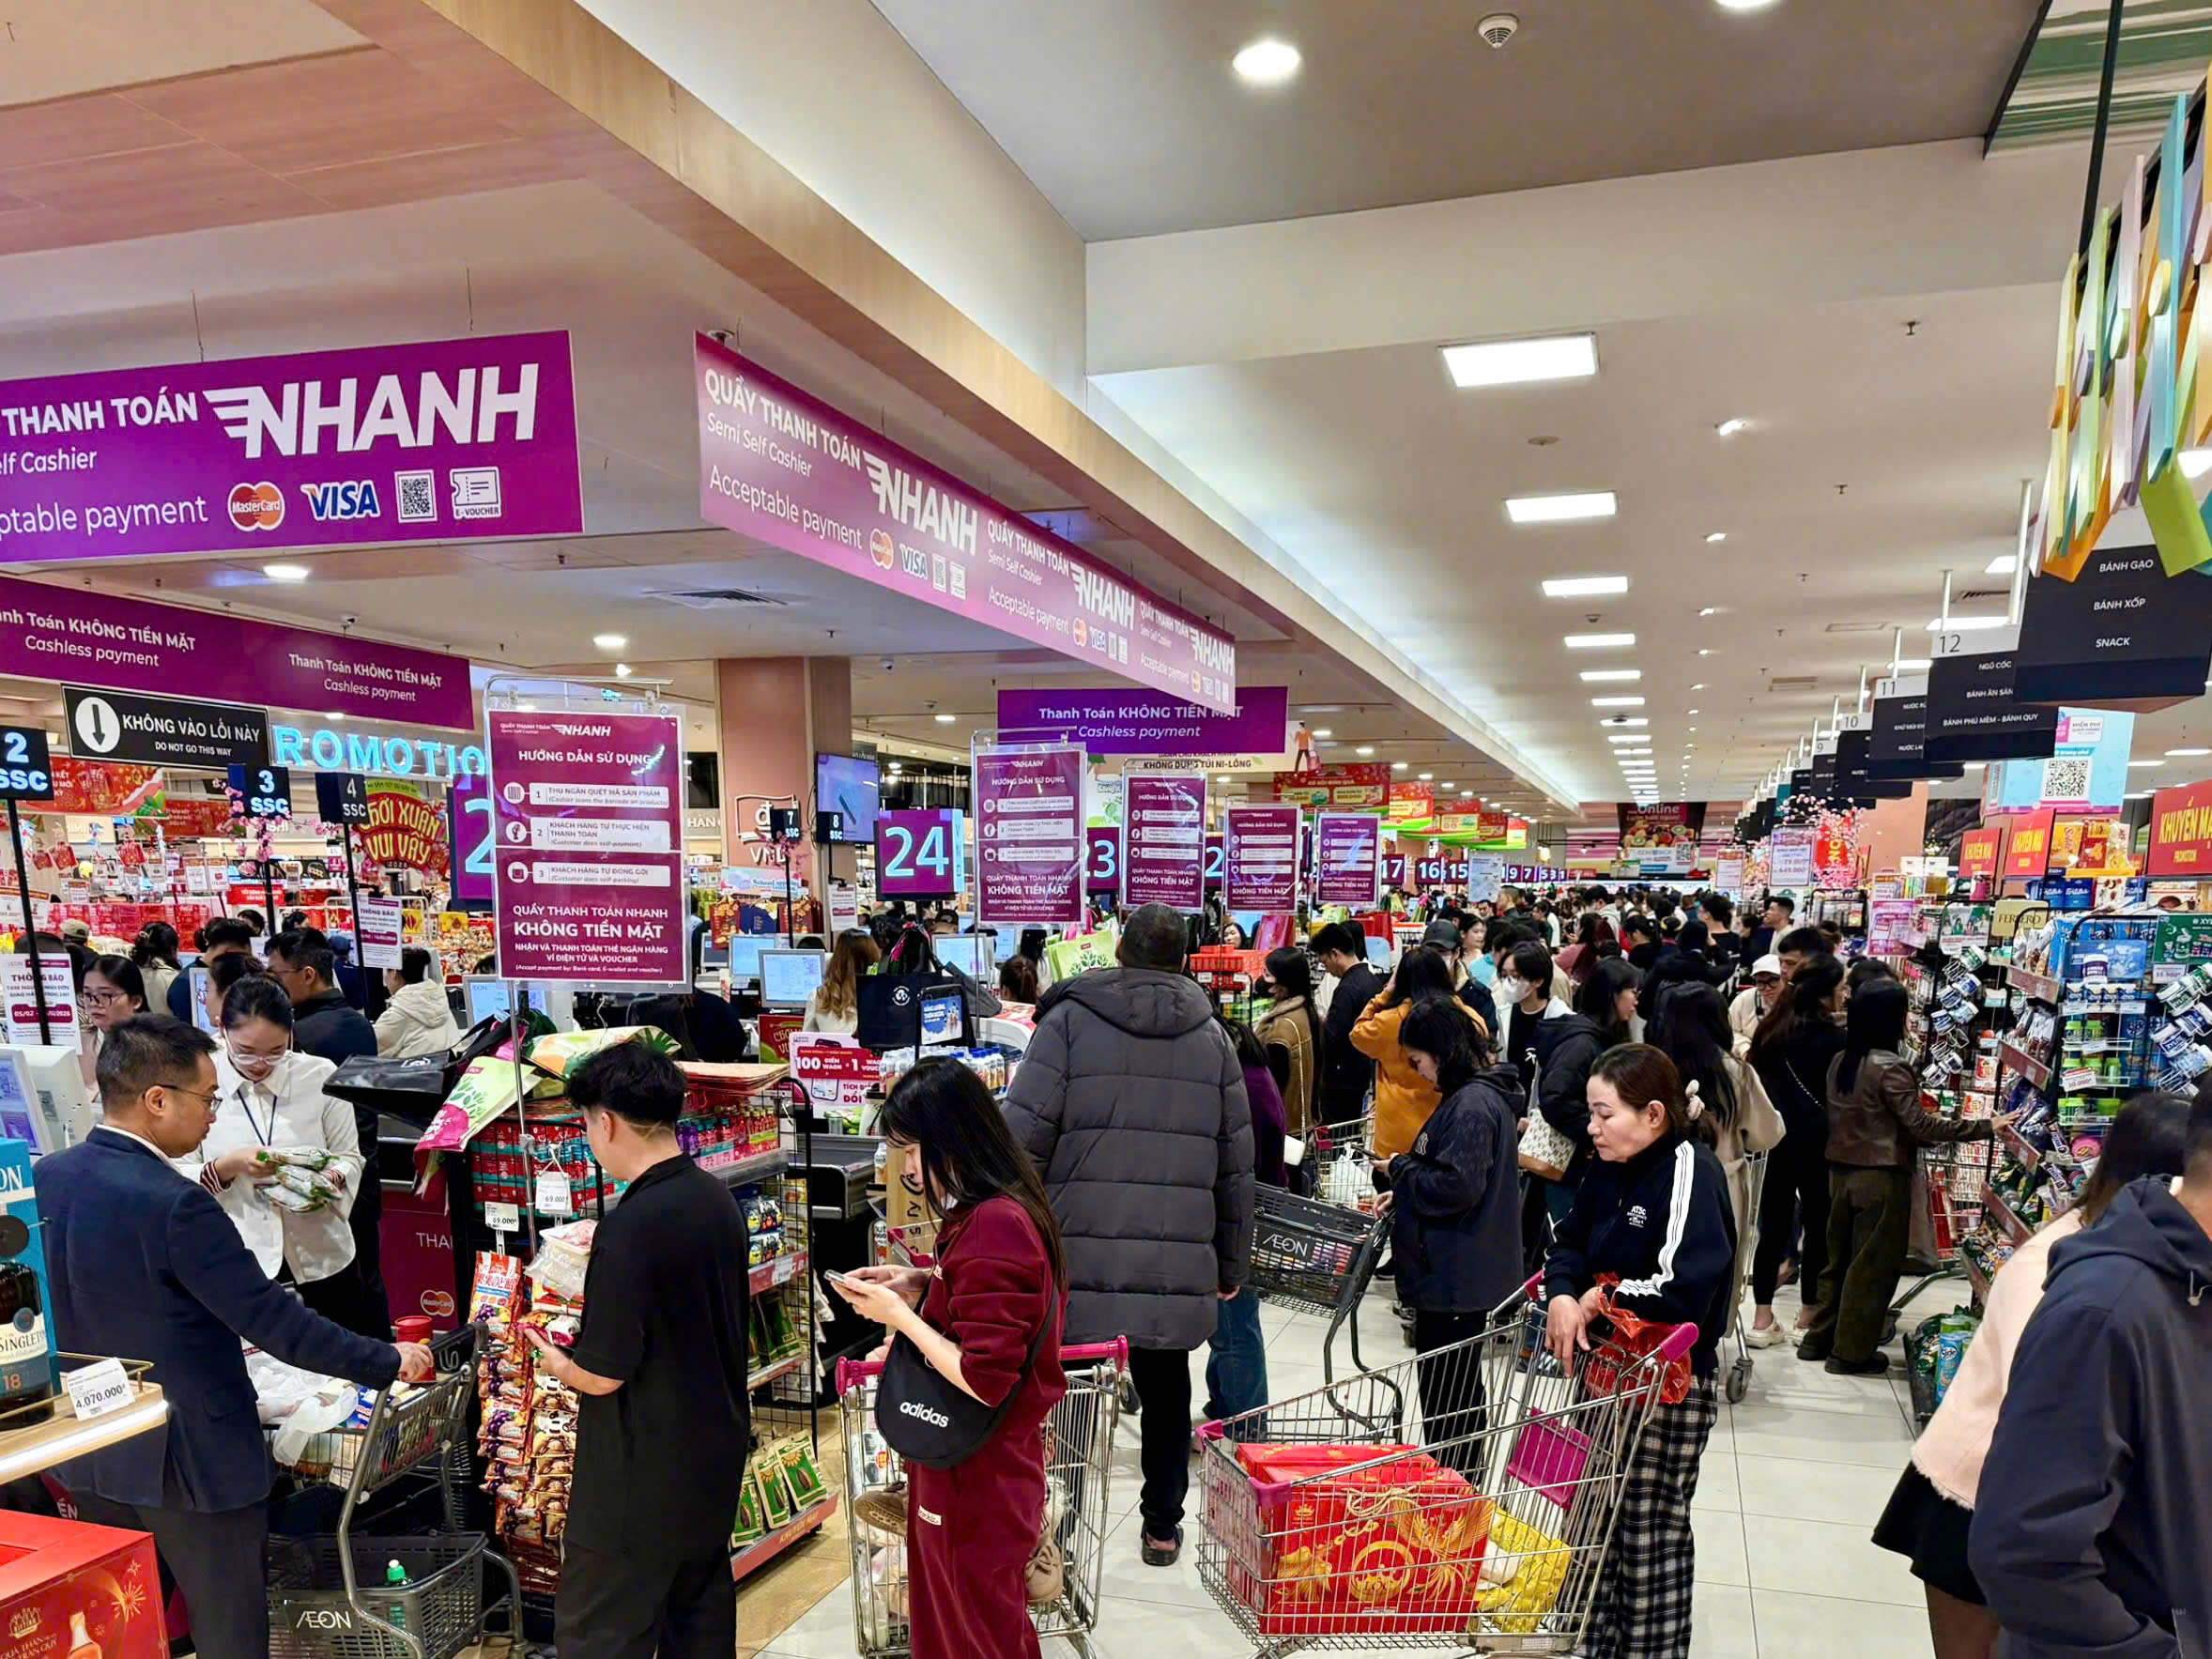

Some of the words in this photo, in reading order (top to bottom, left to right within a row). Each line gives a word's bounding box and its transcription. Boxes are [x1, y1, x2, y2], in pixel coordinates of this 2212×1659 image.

[2, 401, 104, 437] THANH
[112, 387, 198, 428] TOÁN
[203, 363, 539, 458] NHANH
[707, 412, 740, 444] Semi
[743, 429, 767, 454] Self
[769, 443, 812, 478] Cashier
[20, 449, 97, 472] Cashier
[705, 368, 757, 416] QUẦY
[760, 395, 818, 449] THANH
[821, 435, 862, 471] TOÁN
[863, 450, 978, 556] NHANH
[232, 499, 281, 514] MasterCard
[306, 482, 377, 517] VISA
[710, 466, 799, 523] Acceptable
[803, 508, 862, 549] payment
[85, 495, 208, 536] payment
[899, 544, 929, 580] VISA
[988, 548, 1005, 569] Semi
[1006, 557, 1020, 576] Self
[1019, 564, 1043, 587] Cashier
[2099, 561, 2128, 573] BÁNH
[2130, 559, 2154, 571] GẠO
[1016, 532, 1046, 563] THANH
[1047, 546, 1069, 576] TOÁN
[1070, 561, 1135, 631] NHANH
[2094, 599, 2122, 610] BÁNH
[2125, 596, 2145, 608] XỐP
[988, 586, 1036, 621] Acceptable
[1036, 607, 1069, 637] payment
[26, 611, 65, 632] Toán
[69, 616, 126, 643] KHÔNG
[129, 624, 162, 647] TIỀN
[165, 630, 195, 653] MẶT
[1940, 634, 1960, 653] 12
[2096, 637, 2130, 648] SNACK
[25, 635, 92, 657] Cashless
[95, 645, 159, 668] payment
[1189, 626, 1235, 676] NHANH
[289, 653, 324, 670] Thanh
[326, 658, 351, 675] Toán
[353, 662, 393, 682] KHÔNG
[395, 666, 418, 684] TIỀN
[420, 669, 442, 690] MẶT
[324, 678, 369, 698] Cashless
[371, 685, 416, 702] payment
[1882, 681, 1896, 696] 11
[1967, 690, 1985, 699] BÁNH
[1039, 707, 1080, 719] Thanh
[1083, 706, 1114, 719] Toán
[1118, 703, 1171, 718] KHÔNG
[123, 710, 176, 735] KHÔNG
[177, 713, 207, 737] VÀO
[233, 720, 261, 743] NÀY
[1844, 715, 1859, 729] 10
[1943, 718, 1962, 727] BÁNH
[2002, 714, 2021, 723] BÁNH
[2023, 713, 2038, 721] QUY
[551, 724, 611, 736] NHANH
[1079, 725, 1136, 738] Cashless
[1140, 725, 1201, 740] payment
[4, 732, 30, 763] 2
[155, 741, 166, 751] DO
[167, 742, 184, 754] NOT
[186, 744, 197, 754] GO
[198, 745, 214, 756] THIS
[216, 747, 232, 757] WAY
[1817, 743, 1824, 752] 9
[518, 748, 563, 761] HƯỚNG
[566, 747, 593, 762] DẪN
[616, 753, 651, 766] DỤNG
[1144, 760, 1173, 769] KHÔNG
[1201, 759, 1214, 768] TÚI
[1216, 759, 1252, 768] NI-LÔNG
[258, 770, 275, 793] 3
[346, 778, 357, 798] 4
[251, 797, 289, 814] SSC
[343, 803, 367, 817] SSC
[1638, 804, 1680, 814] Online
[787, 810, 794, 825] 7
[833, 814, 839, 828] 8
[2159, 796, 2198, 844] KHUYẾN
[785, 827, 800, 837] SSC
[830, 830, 843, 840] SSC
[366, 833, 395, 861] VUI
[885, 826, 949, 877] 24
[1381, 859, 1403, 879] 17
[1419, 862, 1439, 878] 16
[1450, 863, 1467, 879] 15
[1524, 868, 1531, 878] 7
[1542, 868, 1548, 878] 5
[1132, 875, 1159, 884] KHÔNG
[988, 883, 1022, 895] KHÔNG
[547, 906, 588, 916] THANH
[591, 904, 622, 917] TOÁN
[626, 908, 668, 918] NHANH
[514, 919, 578, 937] KHÔNG
[583, 919, 622, 938] TIỀN
[628, 922, 664, 942] MẶT
[515, 943, 538, 952] NHẬN
[540, 943, 550, 951] VÀ
[551, 944, 578, 952] THANH
[580, 944, 603, 953] TOÁN
[621, 944, 643, 954] NGÂN
[645, 945, 668, 954] HÀNG
[546, 953, 555, 961] VÍ
[601, 955, 637, 963] VOUCHER
[796, 1057, 821, 1069] 100
[852, 1058, 858, 1071] 1
[422, 1298, 453, 1308] MasterCard
[3, 1374, 22, 1390] 18
[899, 1401, 949, 1428] adidas
